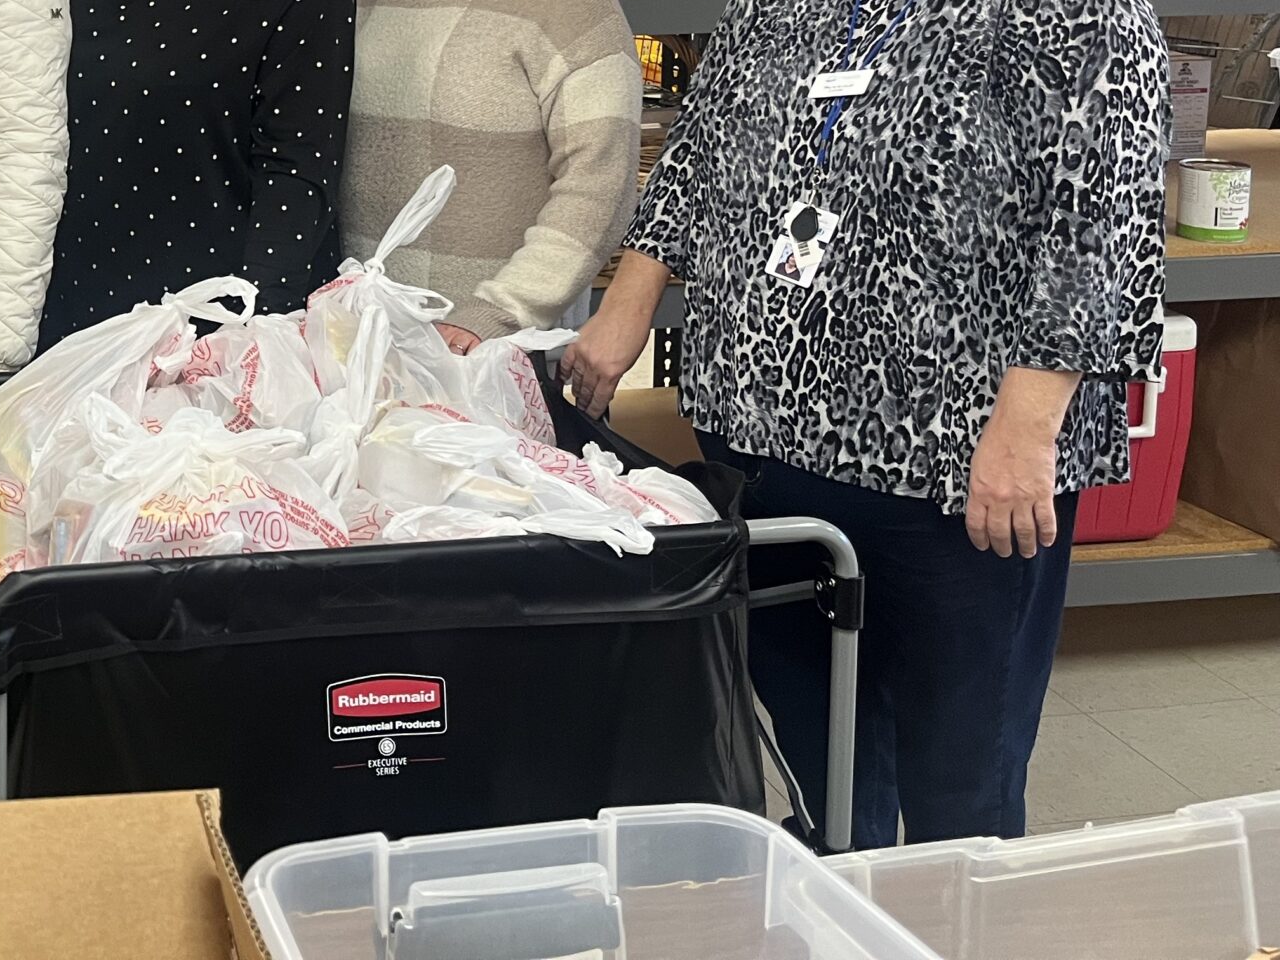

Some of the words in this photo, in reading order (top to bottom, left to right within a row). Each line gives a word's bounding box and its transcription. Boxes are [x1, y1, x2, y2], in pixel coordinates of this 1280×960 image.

[51, 8, 63, 19] MK
[338, 690, 435, 708] Rubbermaid
[334, 722, 393, 735] Commercial
[395, 720, 441, 730] Products
[383, 743, 391, 751] ES
[368, 757, 407, 768] EXECUTIVE
[376, 767, 399, 776] SERIES
